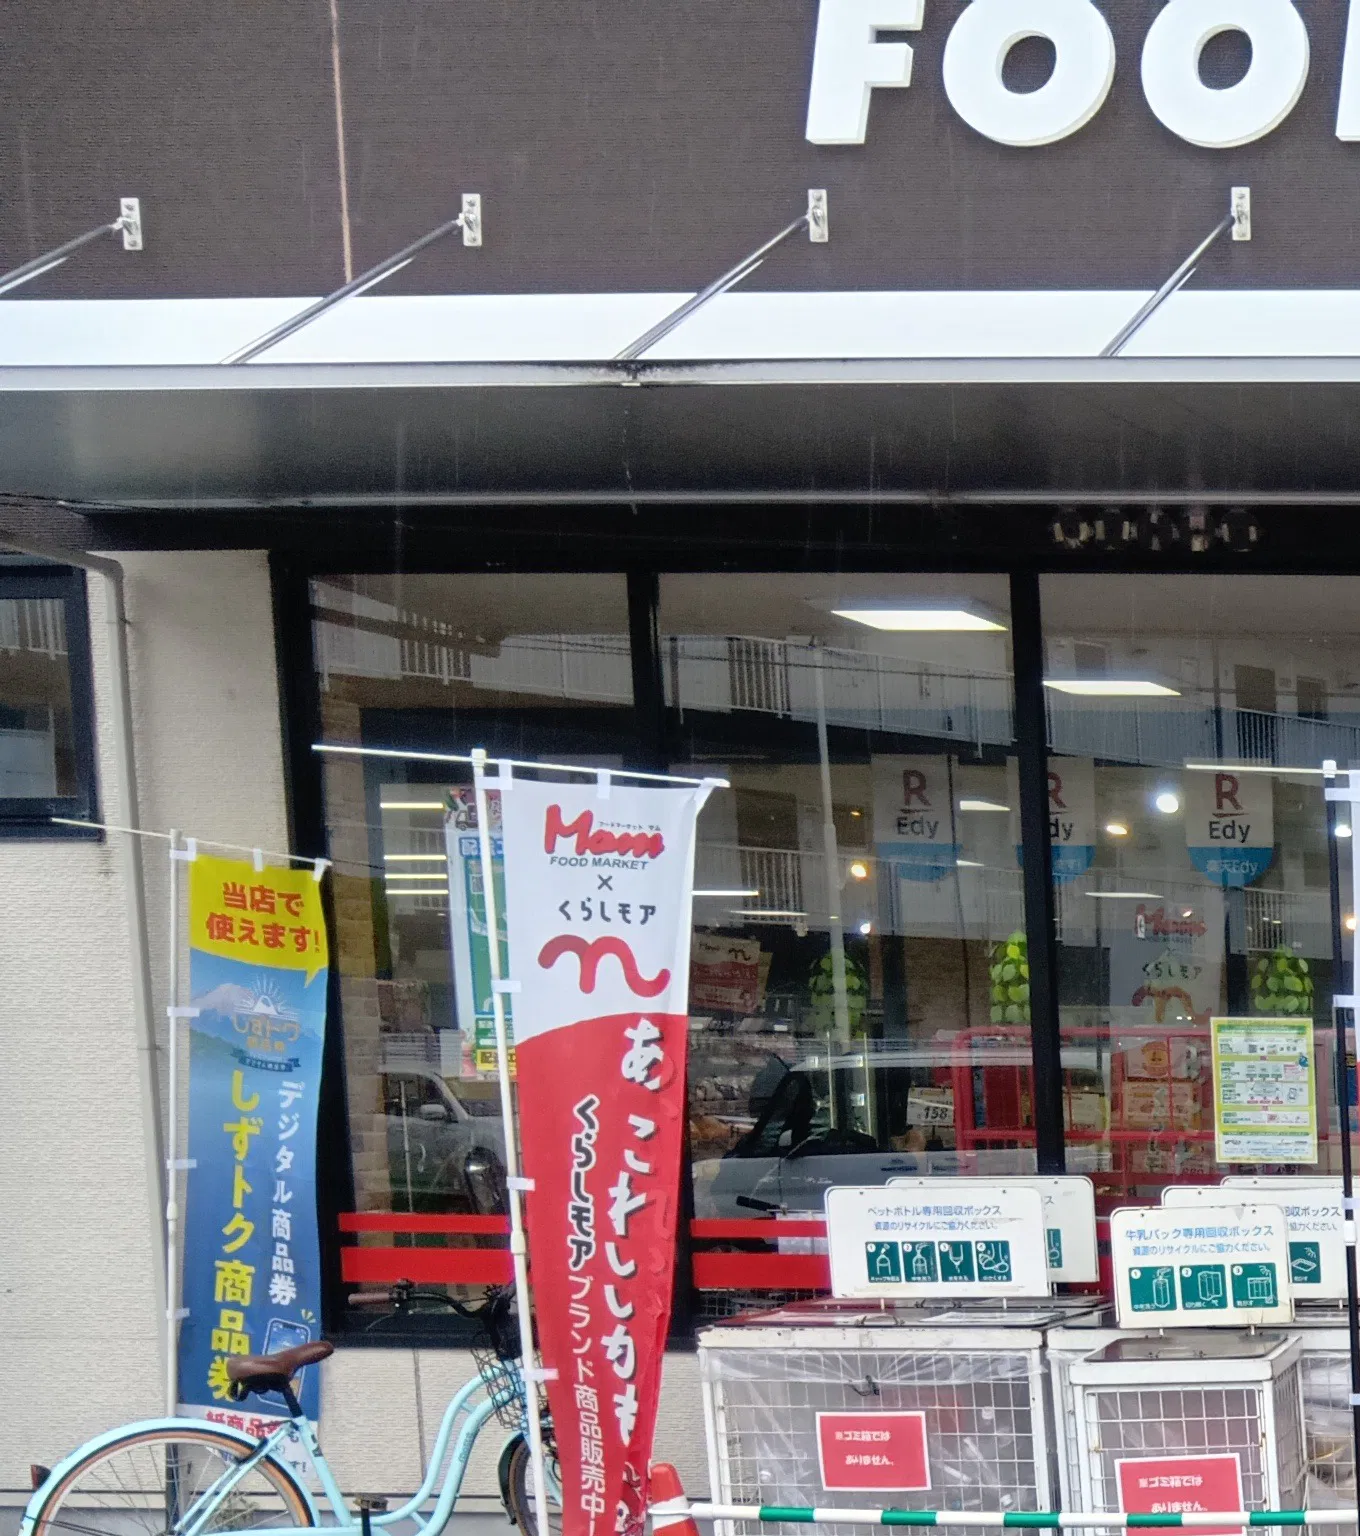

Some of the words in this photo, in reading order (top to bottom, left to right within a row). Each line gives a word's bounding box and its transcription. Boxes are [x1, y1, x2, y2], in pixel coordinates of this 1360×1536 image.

[1216, 773, 1243, 810] R
[1051, 819, 1073, 840] dy
[1209, 820, 1250, 843] Edy
[550, 856, 588, 867] FOOD
[592, 857, 649, 870] MARKET
[223, 882, 304, 917] 当店で
[558, 897, 656, 925] くらしモア
[205, 912, 320, 953] 使えます！
[268, 1080, 305, 1306] デジタル商品券
[867, 1205, 1002, 1217] ペットボトル専用回収ボックス
[1126, 1225, 1274, 1241] 牛乳パック専用回収ボックス
